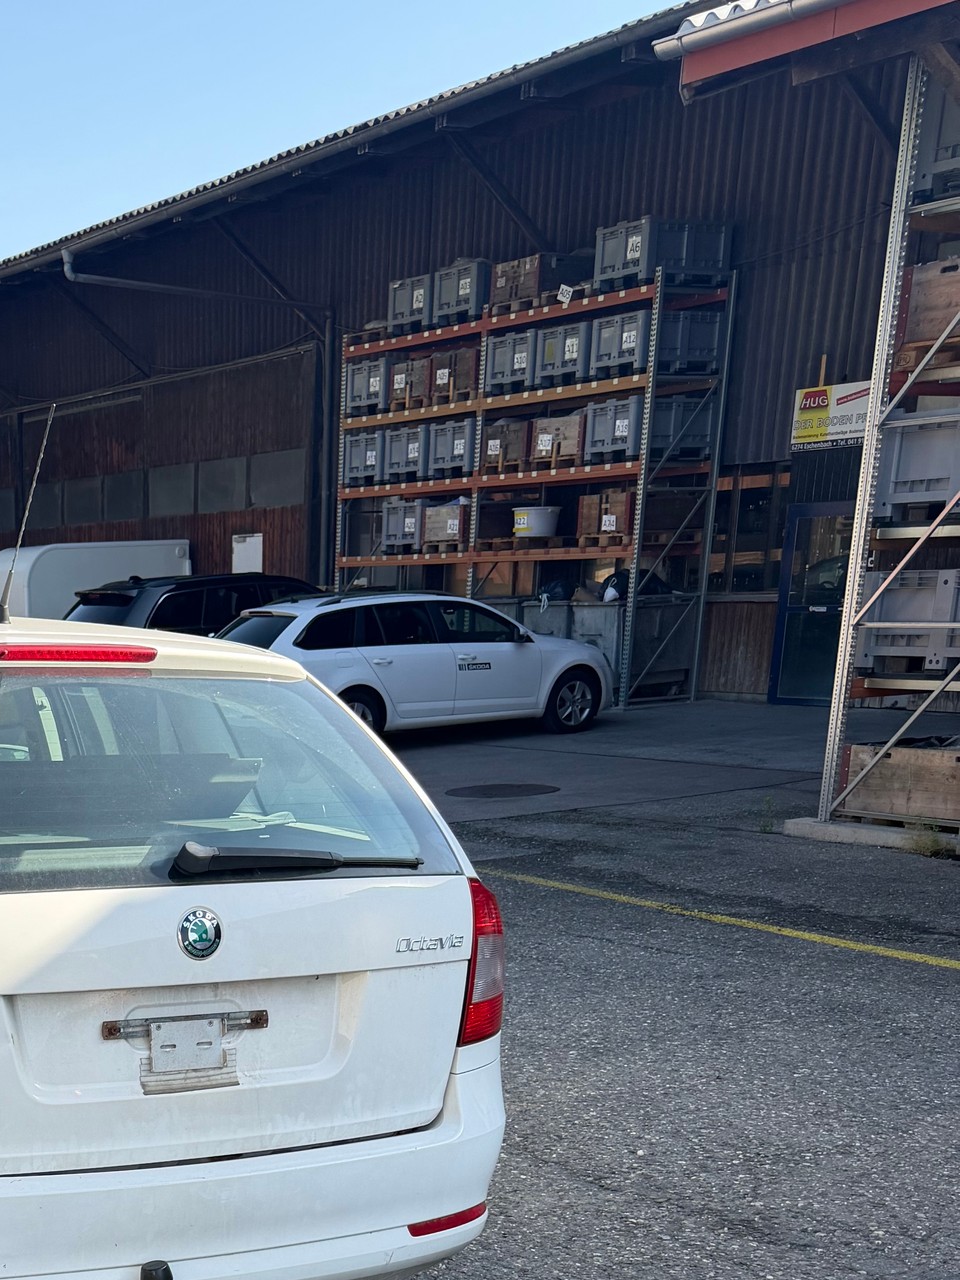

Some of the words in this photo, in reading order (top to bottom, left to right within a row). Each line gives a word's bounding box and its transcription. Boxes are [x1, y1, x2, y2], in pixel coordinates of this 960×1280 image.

[628, 241, 640, 254] A6
[559, 287, 571, 300] A05
[622, 334, 636, 344] A12
[801, 396, 828, 408] HUG
[793, 418, 813, 431] DER
[817, 414, 853, 428] BODEN
[539, 438, 551, 448] A17
[804, 441, 832, 449] Eschenbach
[515, 517, 526, 526] A22
[396, 933, 464, 953] Octavia
